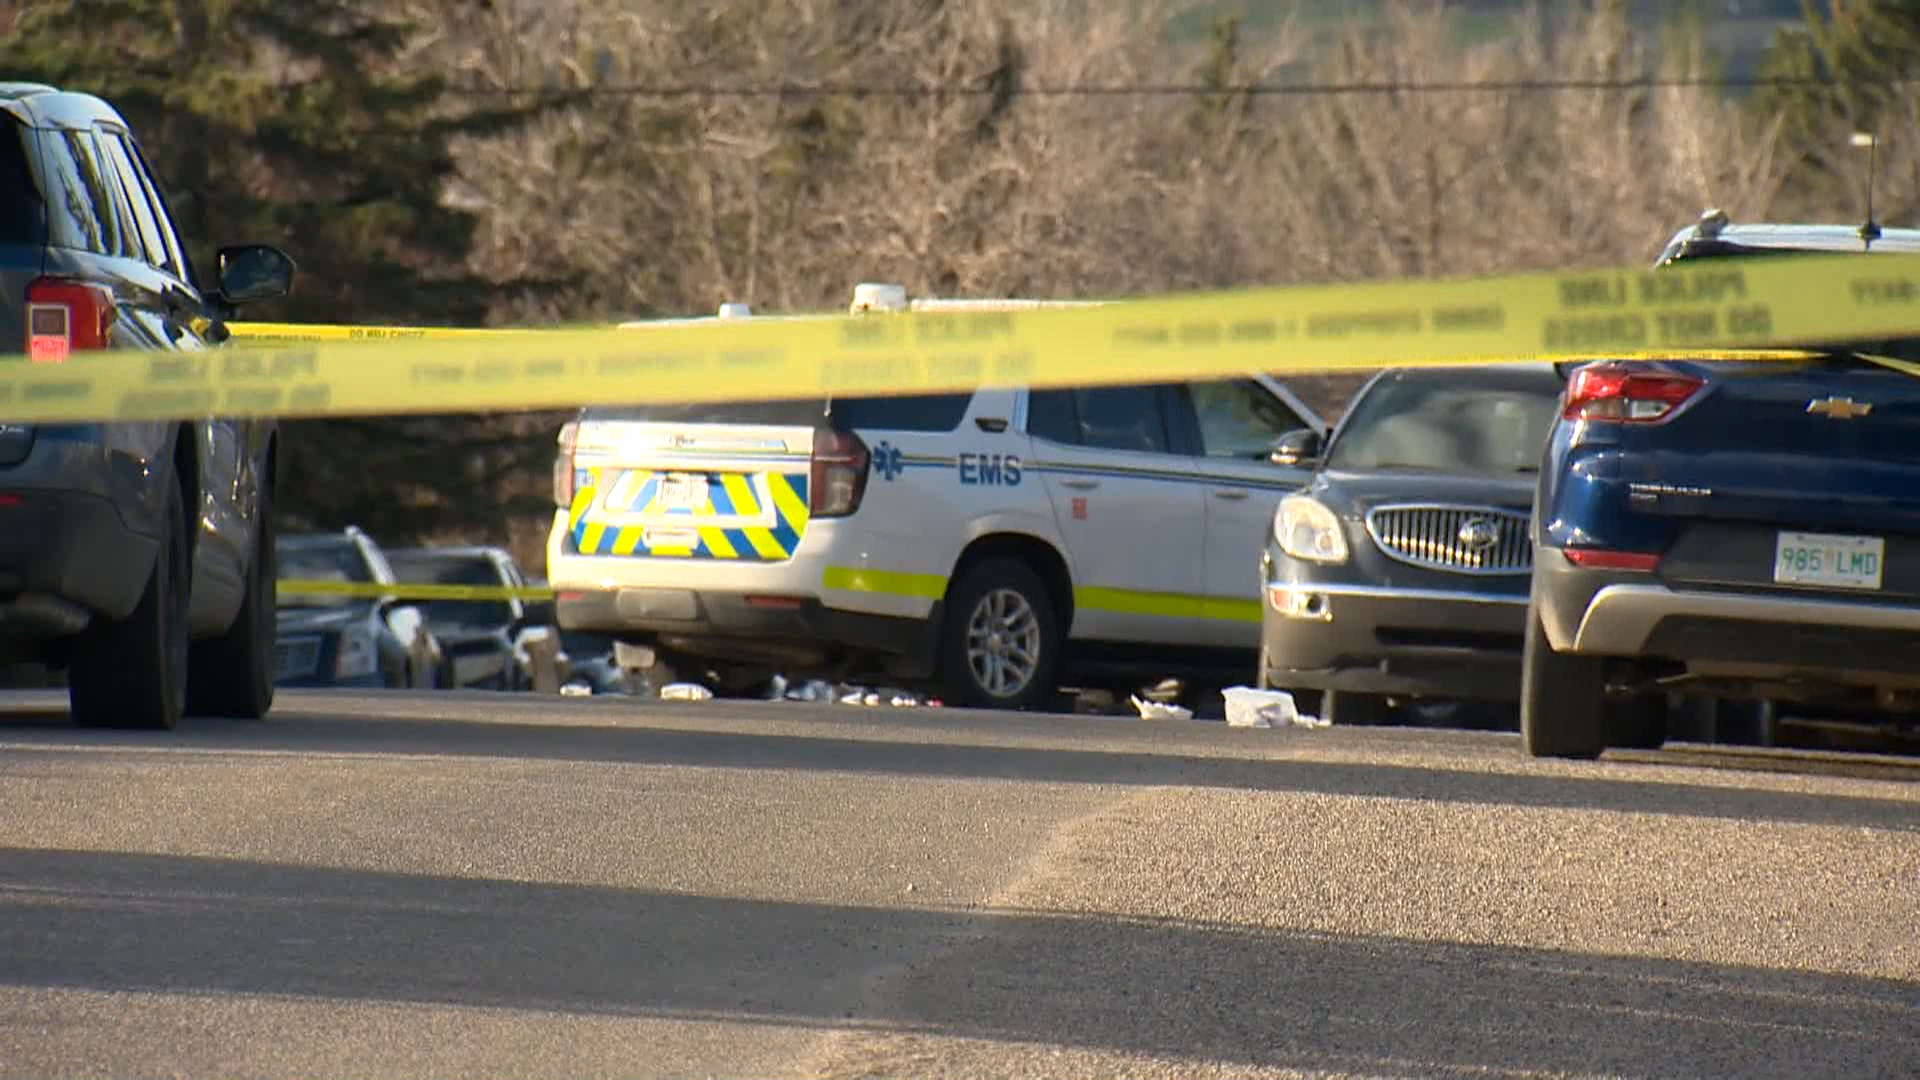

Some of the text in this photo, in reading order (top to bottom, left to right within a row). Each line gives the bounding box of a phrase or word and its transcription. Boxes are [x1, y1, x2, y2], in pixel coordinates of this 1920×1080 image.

[959, 453, 1022, 486] EMS
[1782, 546, 1878, 576] 985 LMD
